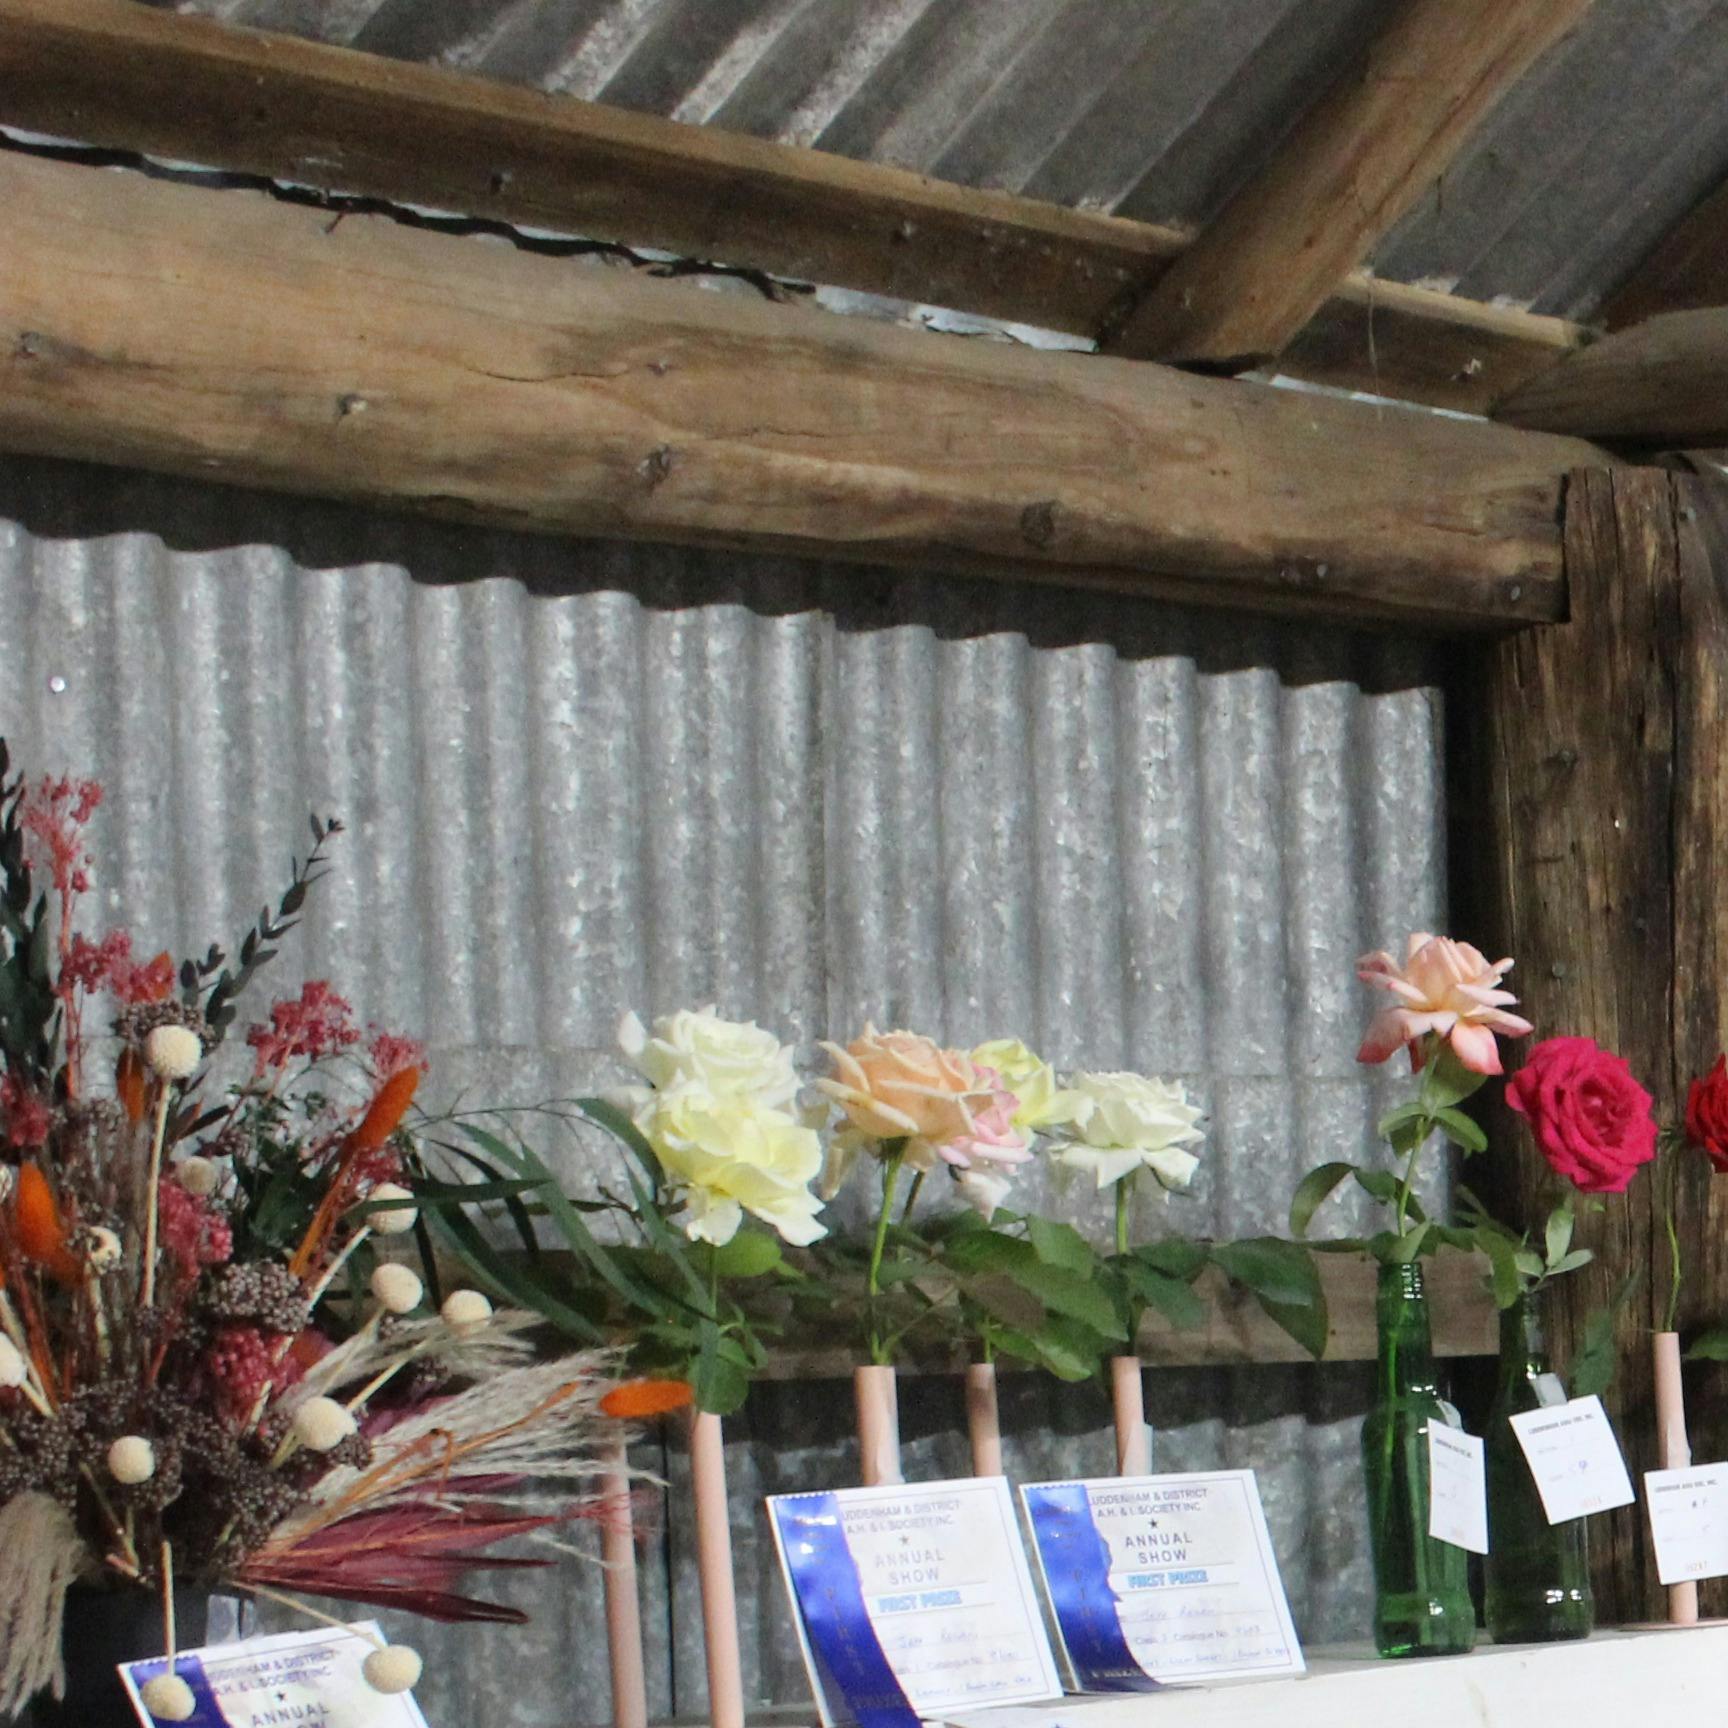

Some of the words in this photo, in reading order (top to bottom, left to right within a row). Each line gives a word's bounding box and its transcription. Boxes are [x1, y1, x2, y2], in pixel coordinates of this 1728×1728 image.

[1091, 1492, 1150, 1506] UDDENHAM
[1163, 1488, 1208, 1501] DISTRICT
[913, 1499, 960, 1514] DISTRICT
[1138, 1503, 1182, 1516] SOCIETY
[888, 1515, 935, 1532] SOCIETY
[1125, 1531, 1193, 1548] ANNUAL
[876, 1548, 945, 1569] ANNUAL
[1138, 1548, 1187, 1564] SHOW
[888, 1567, 940, 1586] SHOW
[1127, 1572, 1166, 1588] FIRST
[1167, 1568, 1209, 1585] PRIZE
[878, 1594, 918, 1613] FIRST
[919, 1589, 963, 1609] PRIZE
[252, 1702, 331, 1727] ANNUAL
